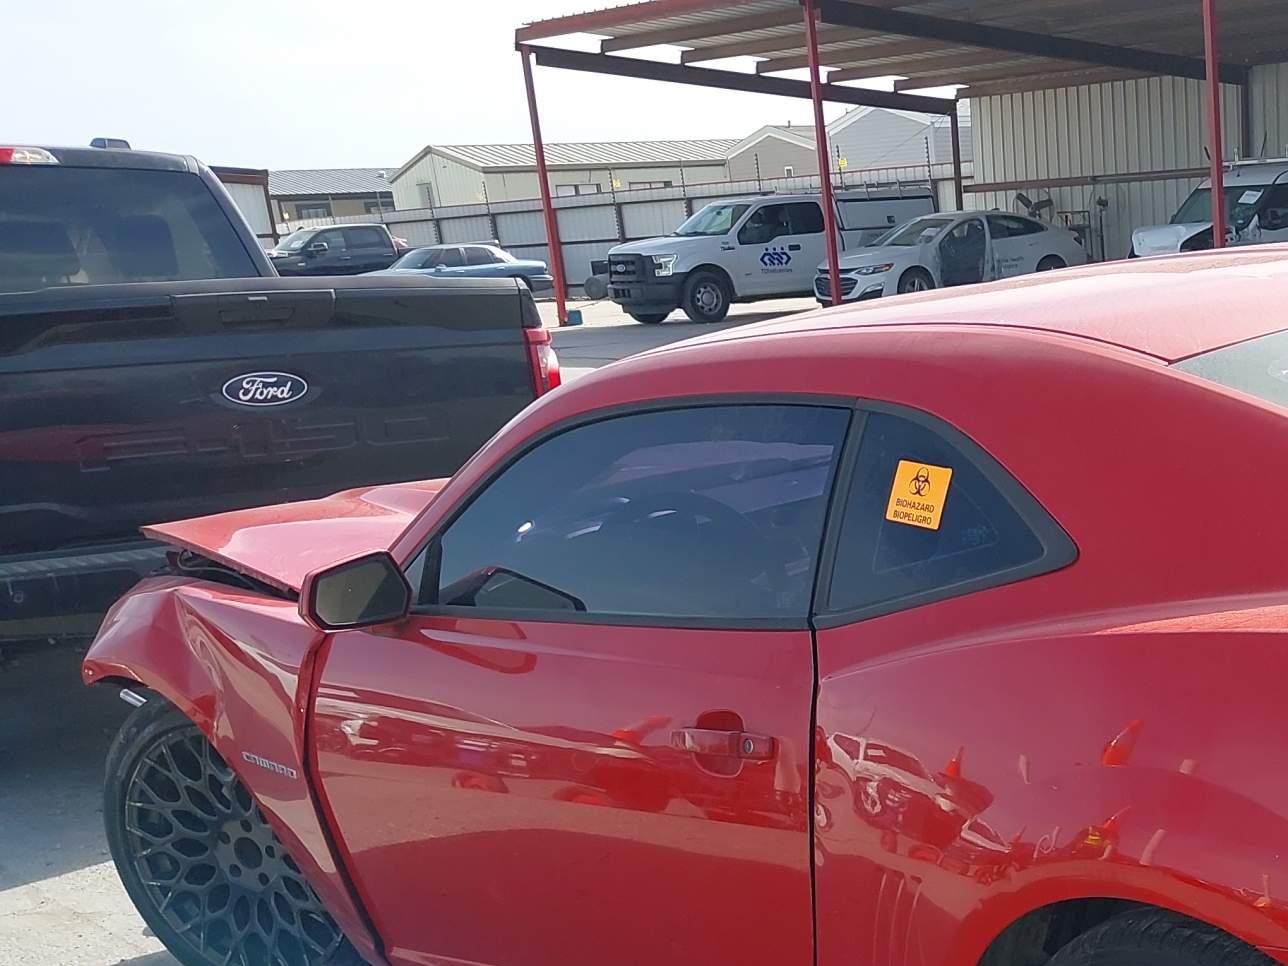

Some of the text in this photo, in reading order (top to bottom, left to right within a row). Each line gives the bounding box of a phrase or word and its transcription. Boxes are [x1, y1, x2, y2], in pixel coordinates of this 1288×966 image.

[238, 376, 293, 401] Ford
[895, 497, 935, 514] BIOHAZARD
[893, 509, 932, 525] BIOPELIGRO
